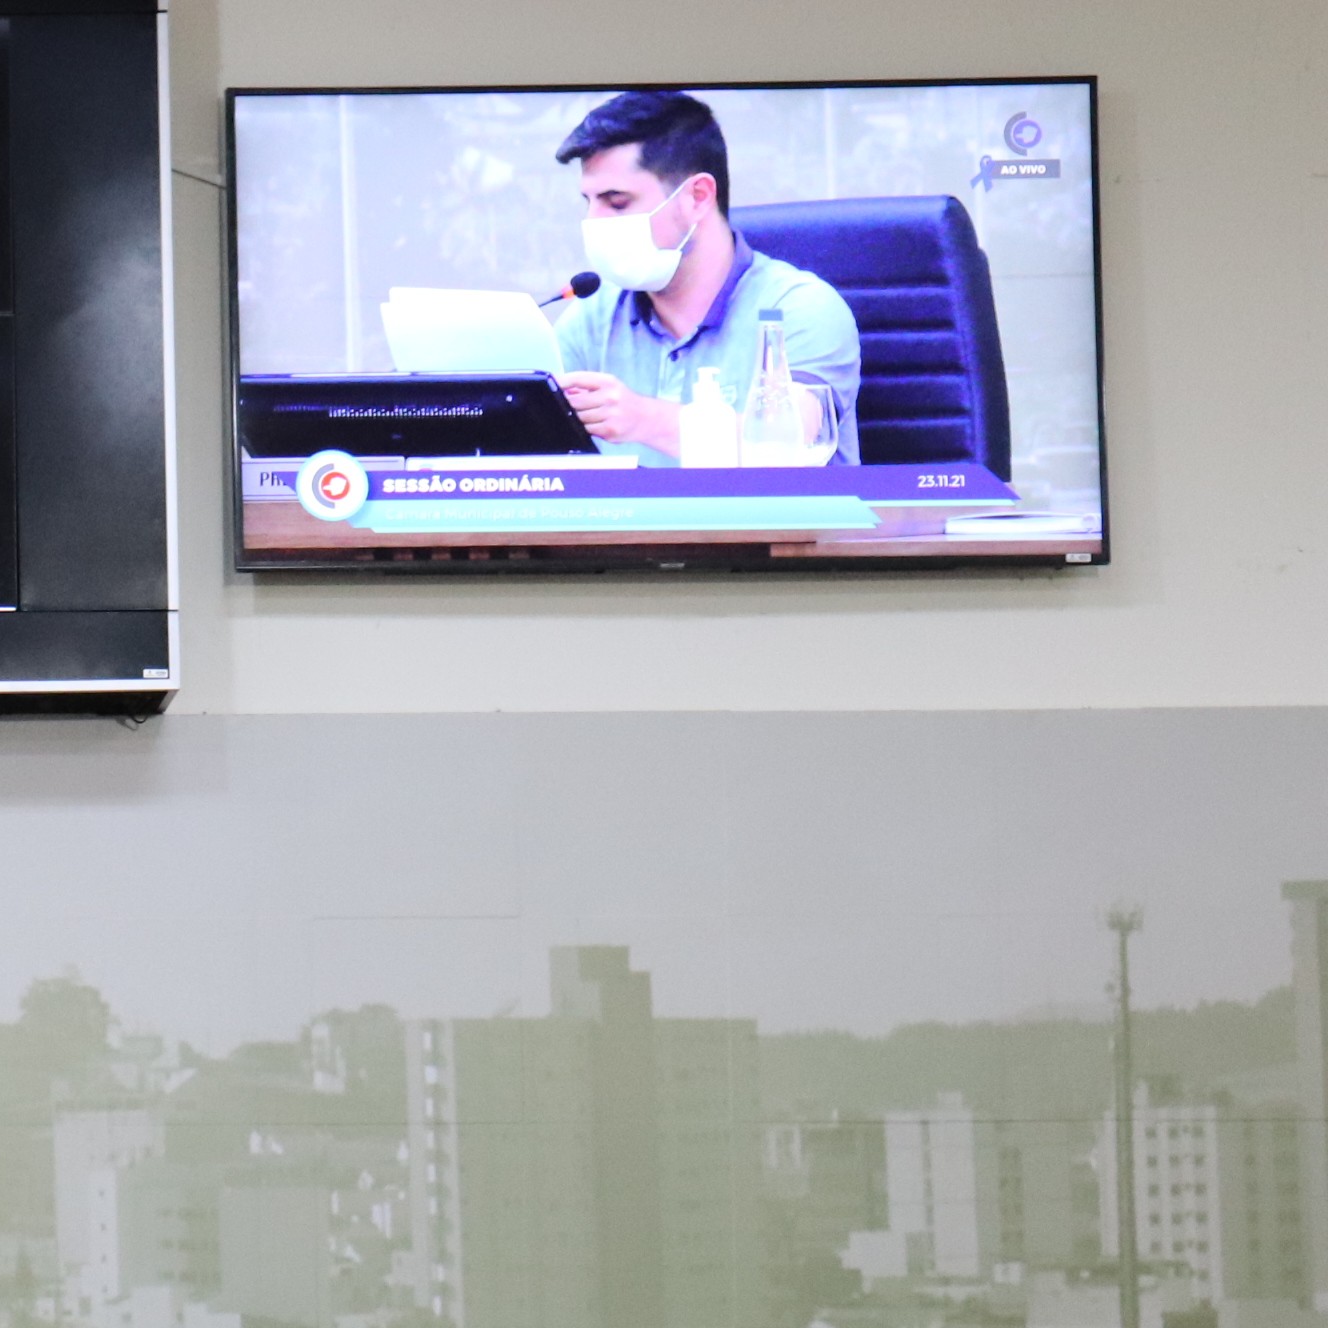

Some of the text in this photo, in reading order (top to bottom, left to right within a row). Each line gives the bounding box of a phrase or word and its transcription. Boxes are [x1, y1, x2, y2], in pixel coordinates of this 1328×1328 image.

[1000, 164, 1047, 175] AO VIVO
[382, 475, 565, 493] SESSÃO ORDINÁRIA
[918, 475, 965, 488] 23.11.21
